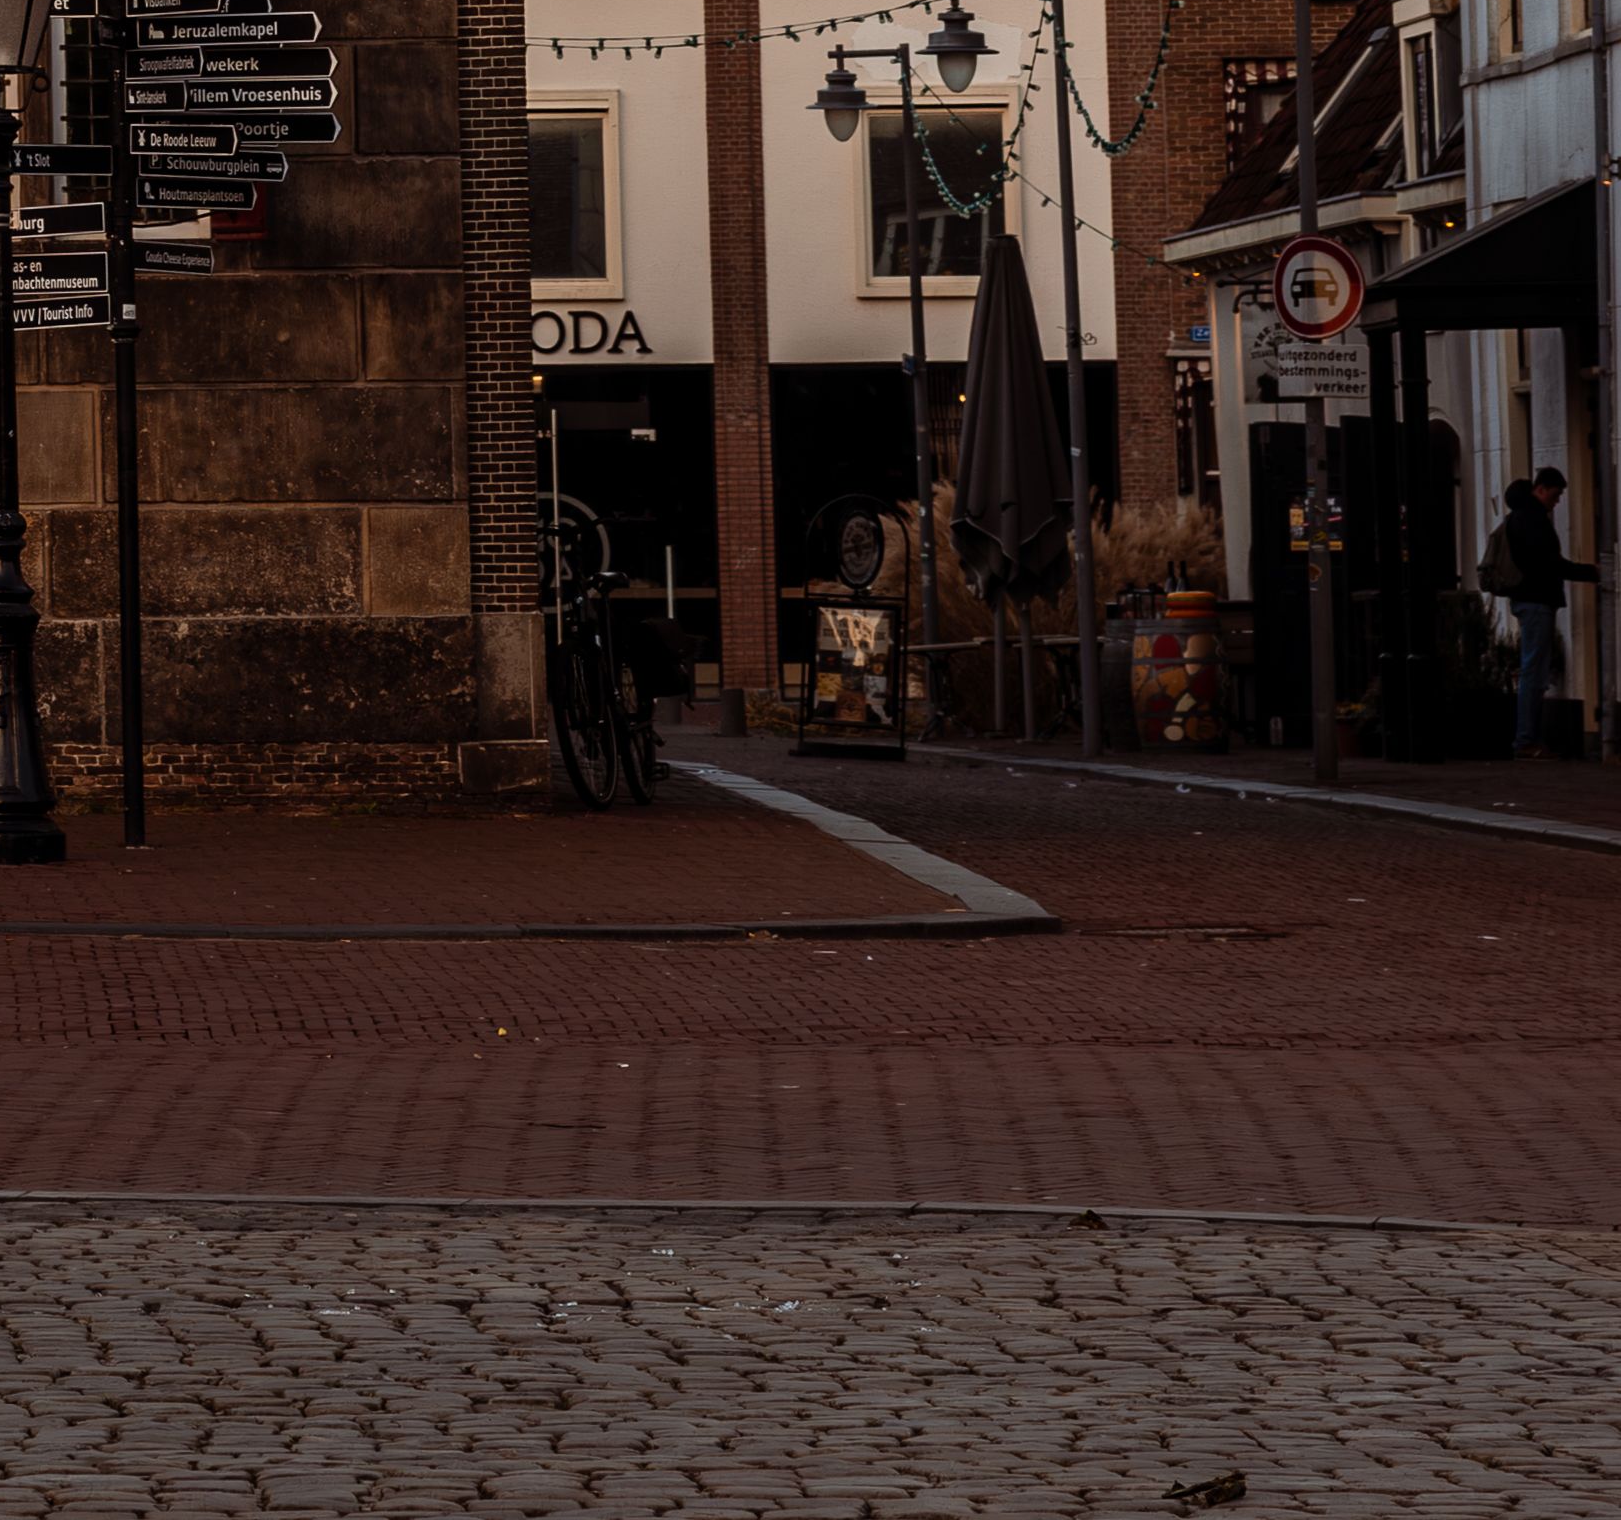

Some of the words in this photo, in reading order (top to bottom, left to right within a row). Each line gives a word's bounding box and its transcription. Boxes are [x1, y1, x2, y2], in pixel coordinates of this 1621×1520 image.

[171, 21, 279, 40] Jeruzalemkapel
[205, 56, 260, 72] wekerk
[190, 87, 229, 103] illem
[232, 86, 323, 103] Vroesenhuis
[150, 133, 162, 147] De
[163, 133, 189, 148] Roode
[190, 134, 217, 148] Leeuw
[34, 153, 51, 168] Slot
[167, 156, 260, 175] Schouwburgplein
[159, 187, 245, 205] Houtmansplantsoen
[29, 263, 43, 272] en
[12, 306, 36, 322] VVV
[42, 304, 74, 321] Tourist
[75, 303, 94, 318] Info
[1279, 350, 1358, 364] uitgezonderd
[1279, 365, 1367, 380] bestemmings-
[1314, 381, 1367, 394] verkeer
